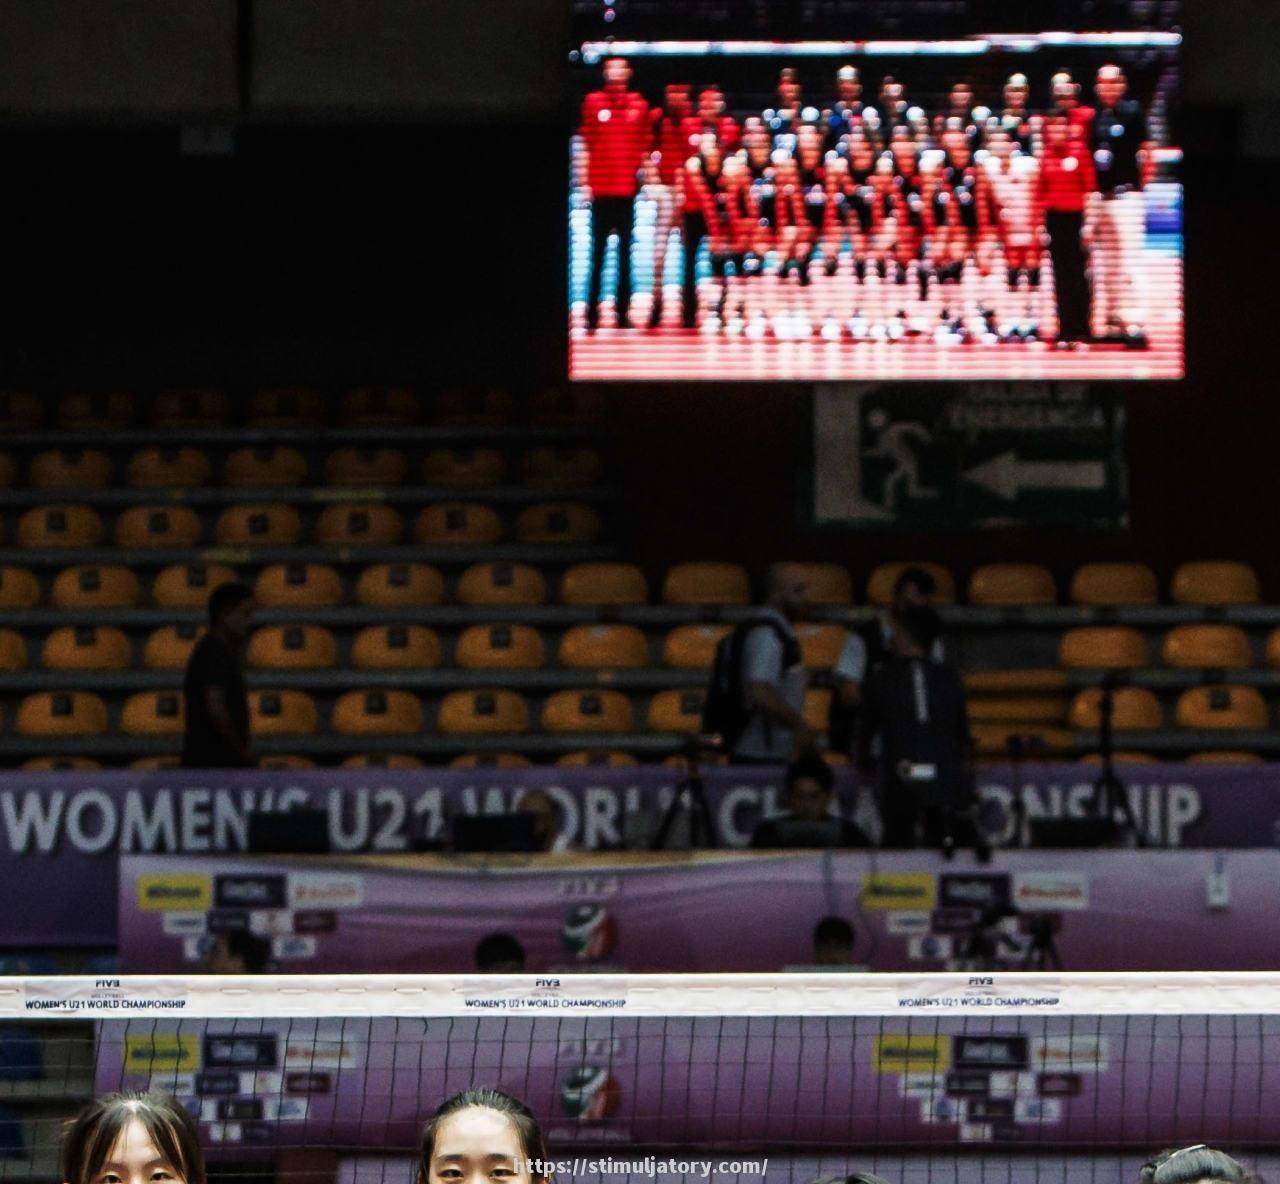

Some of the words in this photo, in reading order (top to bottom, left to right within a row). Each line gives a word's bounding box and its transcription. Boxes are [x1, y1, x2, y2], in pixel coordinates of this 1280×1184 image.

[25, 1000, 67, 1009] WOMEN'S
[70, 1000, 85, 1009] U21
[87, 1000, 119, 1009] WORLD
[121, 1000, 185, 1009] CHAMPIONSHIP
[465, 999, 507, 1009] WOMEN'S
[508, 999, 525, 1009] U21
[527, 999, 559, 1009] WORLD
[561, 999, 626, 1009] CHAMPIONSHIP
[898, 998, 940, 1008] WOMEN'S
[961, 998, 993, 1008] WORLD
[995, 998, 1059, 1008] CHAMPIONSHIP
